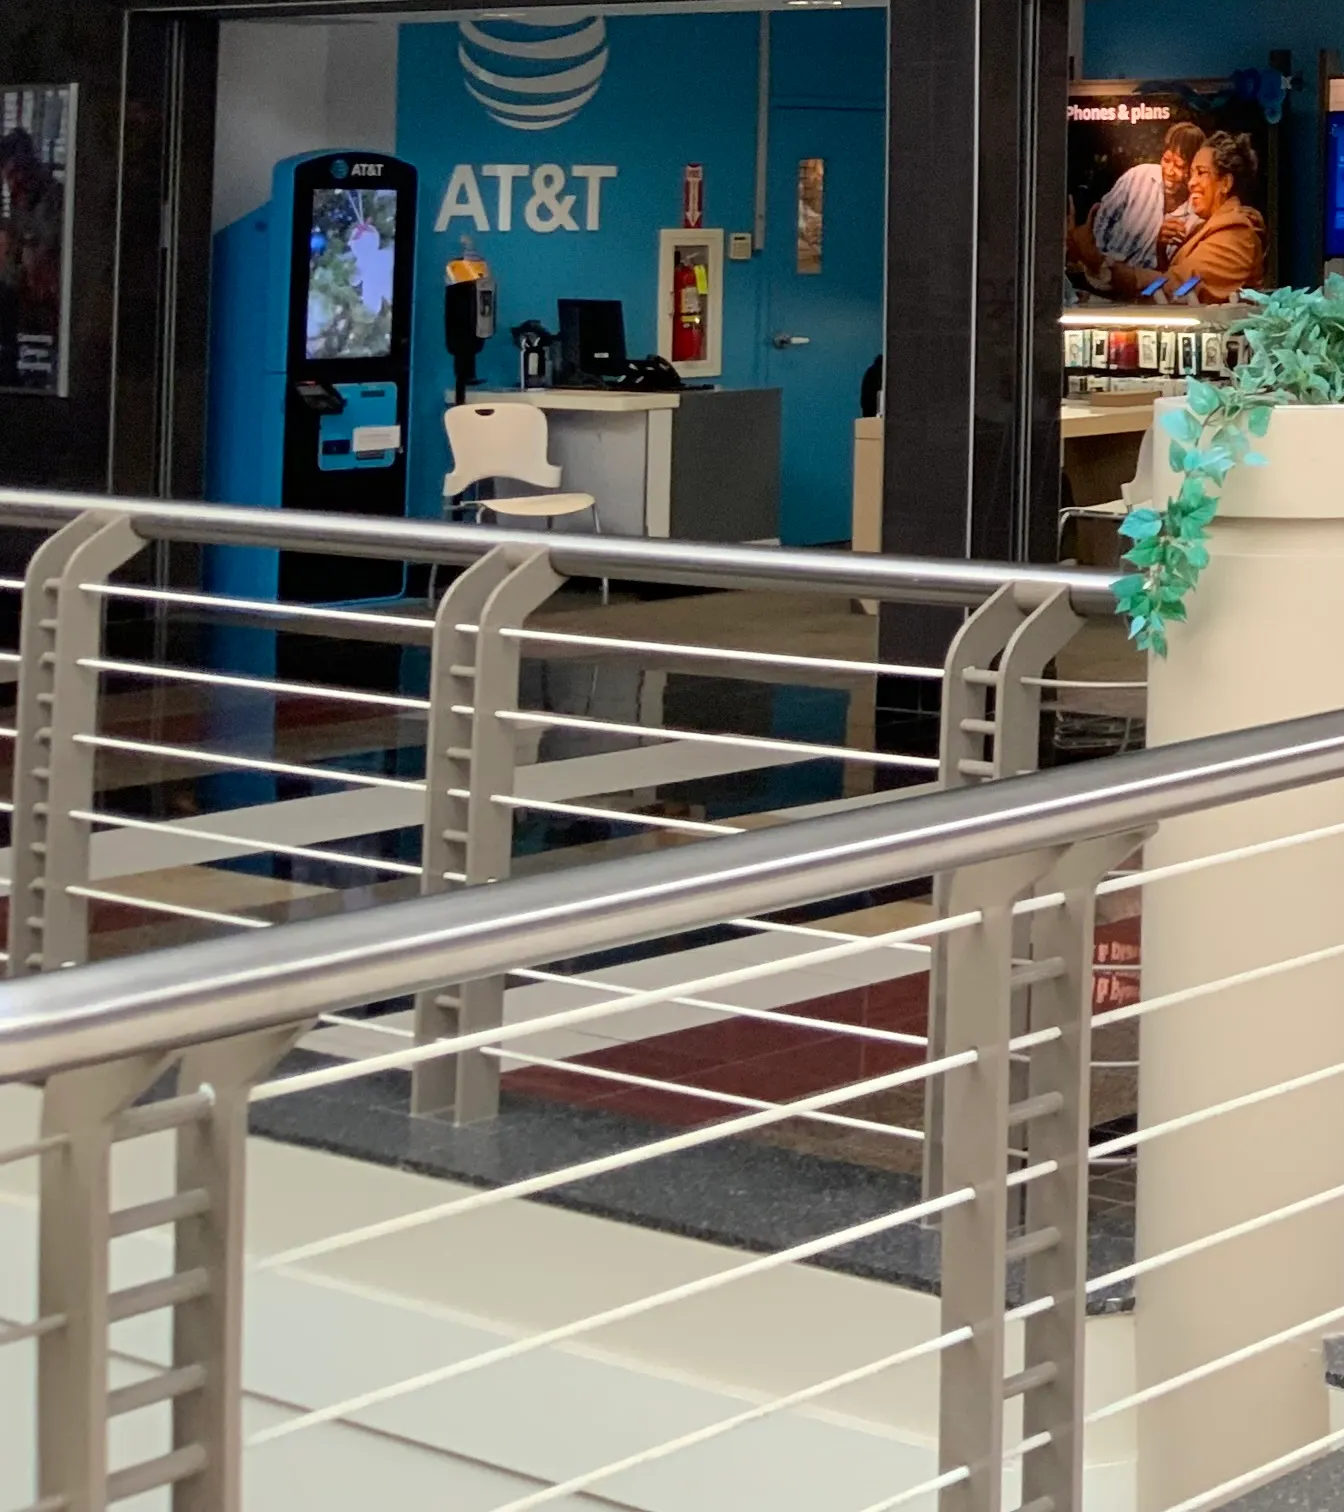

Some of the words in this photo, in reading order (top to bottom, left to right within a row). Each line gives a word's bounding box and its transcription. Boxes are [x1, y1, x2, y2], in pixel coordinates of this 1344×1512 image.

[1066, 104, 1116, 121] Phones
[1117, 104, 1130, 121] &
[1131, 103, 1171, 124] plans
[351, 163, 385, 177] AT&T
[433, 163, 618, 233] AT&T
